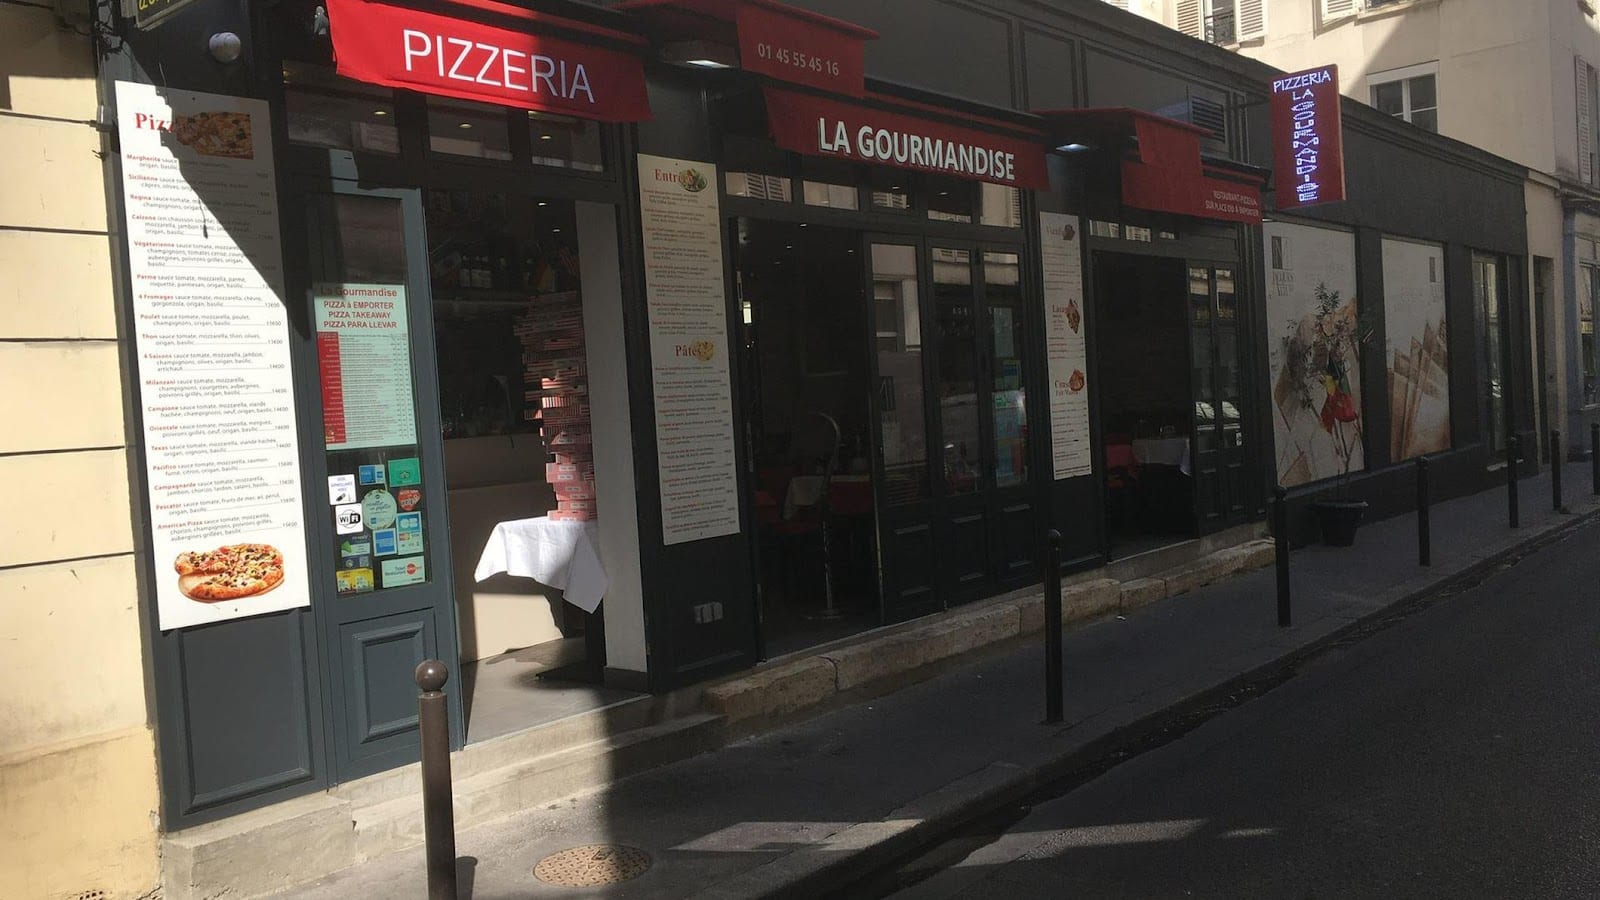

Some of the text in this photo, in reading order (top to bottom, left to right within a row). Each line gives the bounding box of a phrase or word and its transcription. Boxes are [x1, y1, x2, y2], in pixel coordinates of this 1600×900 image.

[402, 29, 595, 104] PIZZERIA
[758, 43, 839, 76] 01 45 55 45 16
[1273, 70, 1331, 93] PIZZERIA
[1292, 89, 1314, 101] LA
[135, 112, 182, 133] Pizz
[818, 117, 1016, 180] LA GOURMANDISE
[321, 286, 398, 298] La Gourmandise
[324, 300, 346, 308] PIZZA
[354, 301, 394, 310] EMPORTER
[350, 311, 391, 319] TAKEAWAY
